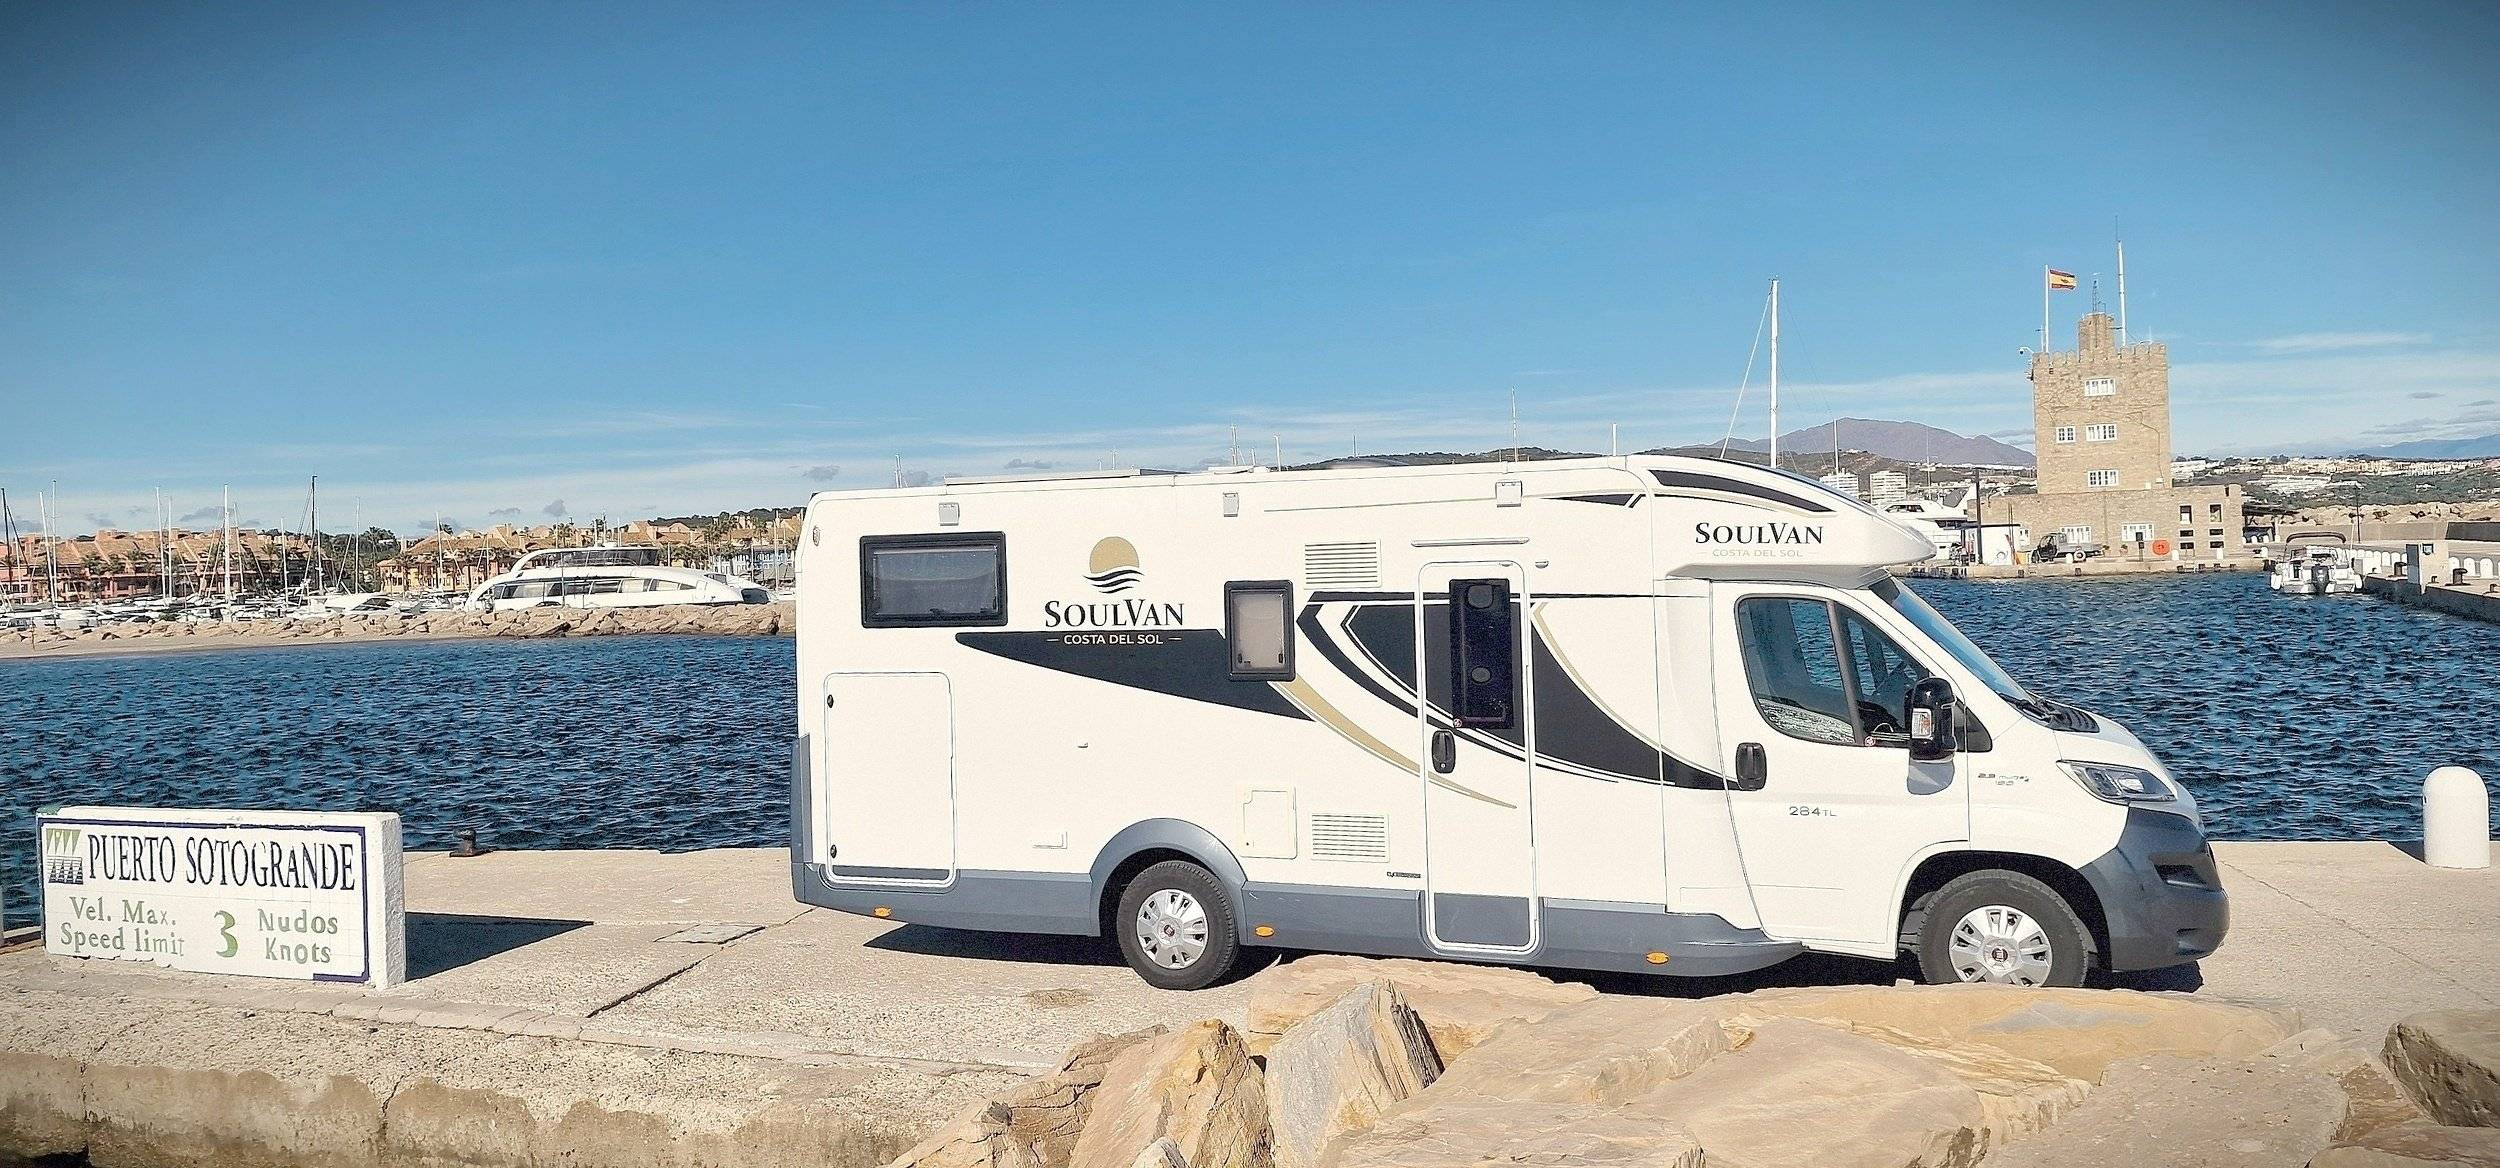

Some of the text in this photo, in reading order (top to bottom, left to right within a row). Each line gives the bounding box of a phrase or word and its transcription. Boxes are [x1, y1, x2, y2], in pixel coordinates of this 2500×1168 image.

[1712, 549, 1804, 557] COSTA DEL SOL
[1063, 633, 1163, 645] COSTA DEL SOL
[87, 833, 355, 891] PUERTO SOTOGRANDE
[69, 896, 176, 926] Vel. Max.
[257, 908, 338, 935] Nudos
[60, 922, 186, 957] Speed limit
[213, 910, 239, 958] 3
[265, 937, 331, 964] Knots
